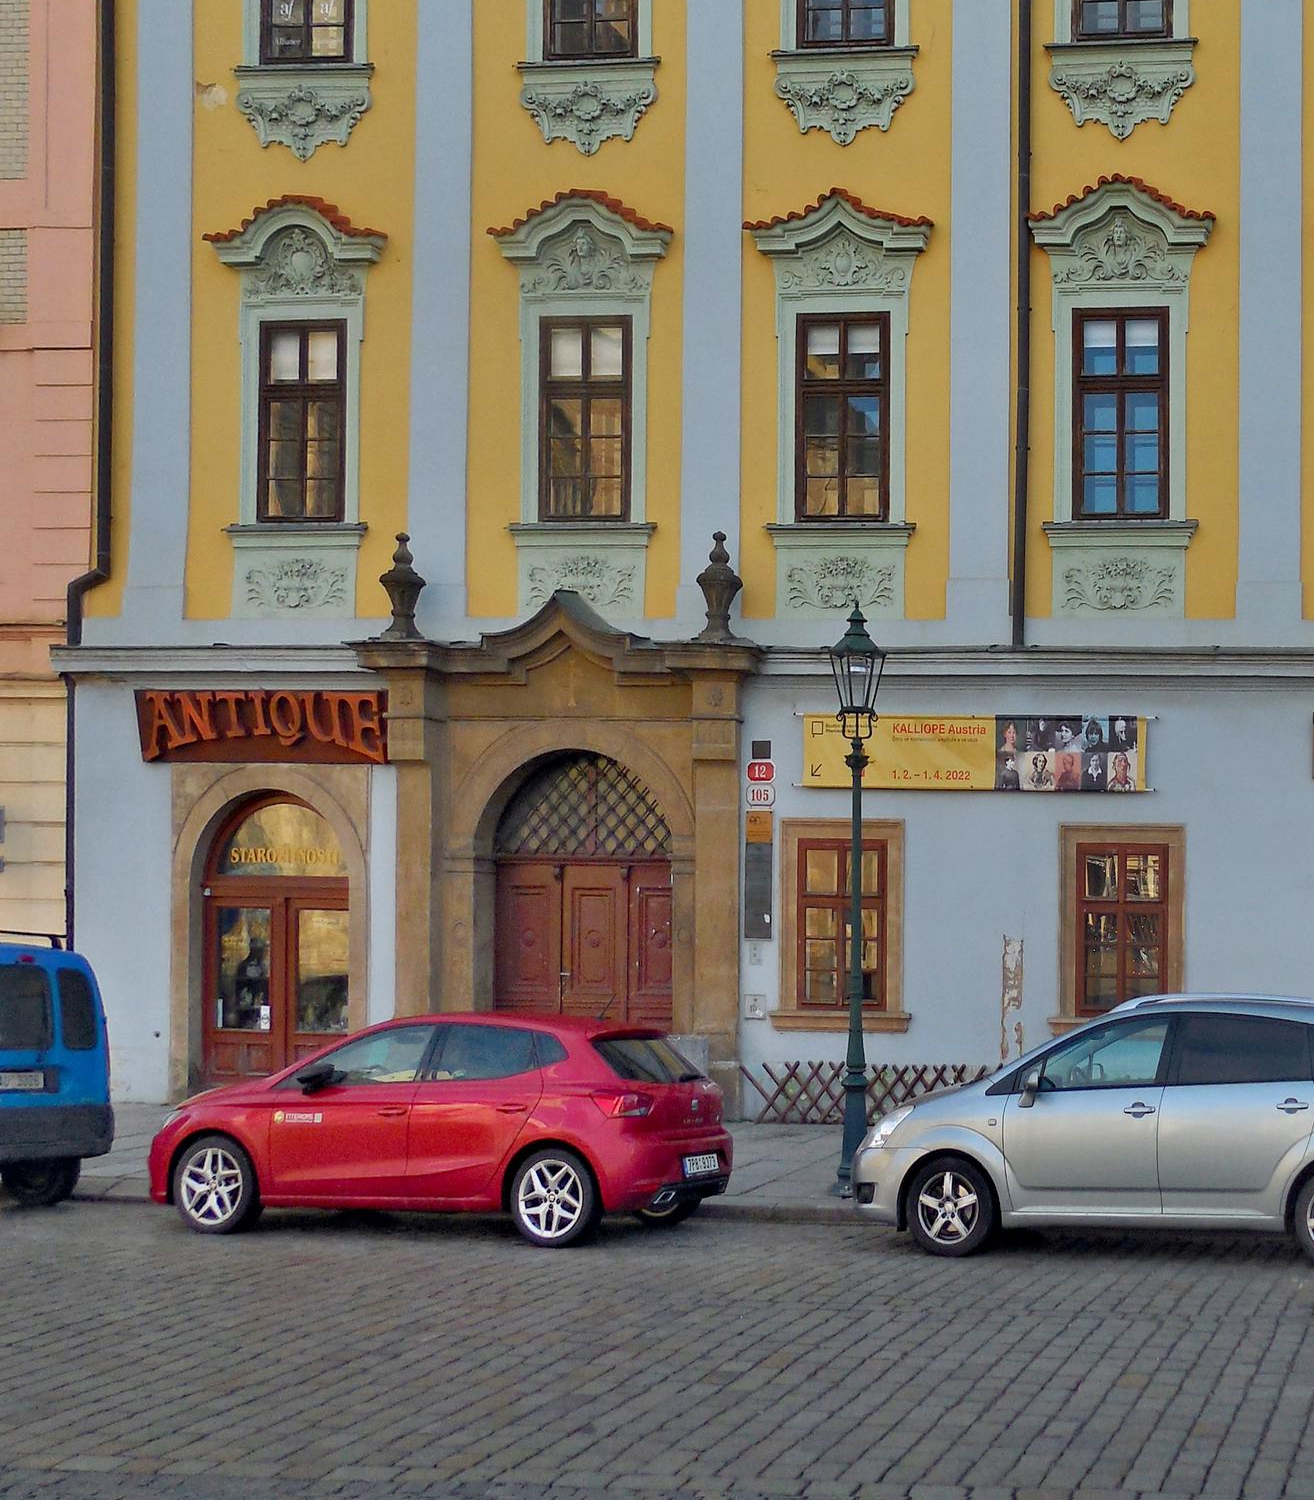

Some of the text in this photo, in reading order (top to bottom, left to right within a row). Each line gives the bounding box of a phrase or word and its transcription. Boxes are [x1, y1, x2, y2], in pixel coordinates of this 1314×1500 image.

[145, 690, 385, 764] ANTIQUE
[892, 723, 986, 735] KALLIOPE Austria
[753, 764, 767, 779] 12
[892, 770, 900, 780] 1.
[903, 770, 912, 780] 2.
[923, 770, 931, 780] 1.
[934, 770, 943, 780] 4.
[945, 770, 971, 781] 2022
[751, 789, 769, 802] 105
